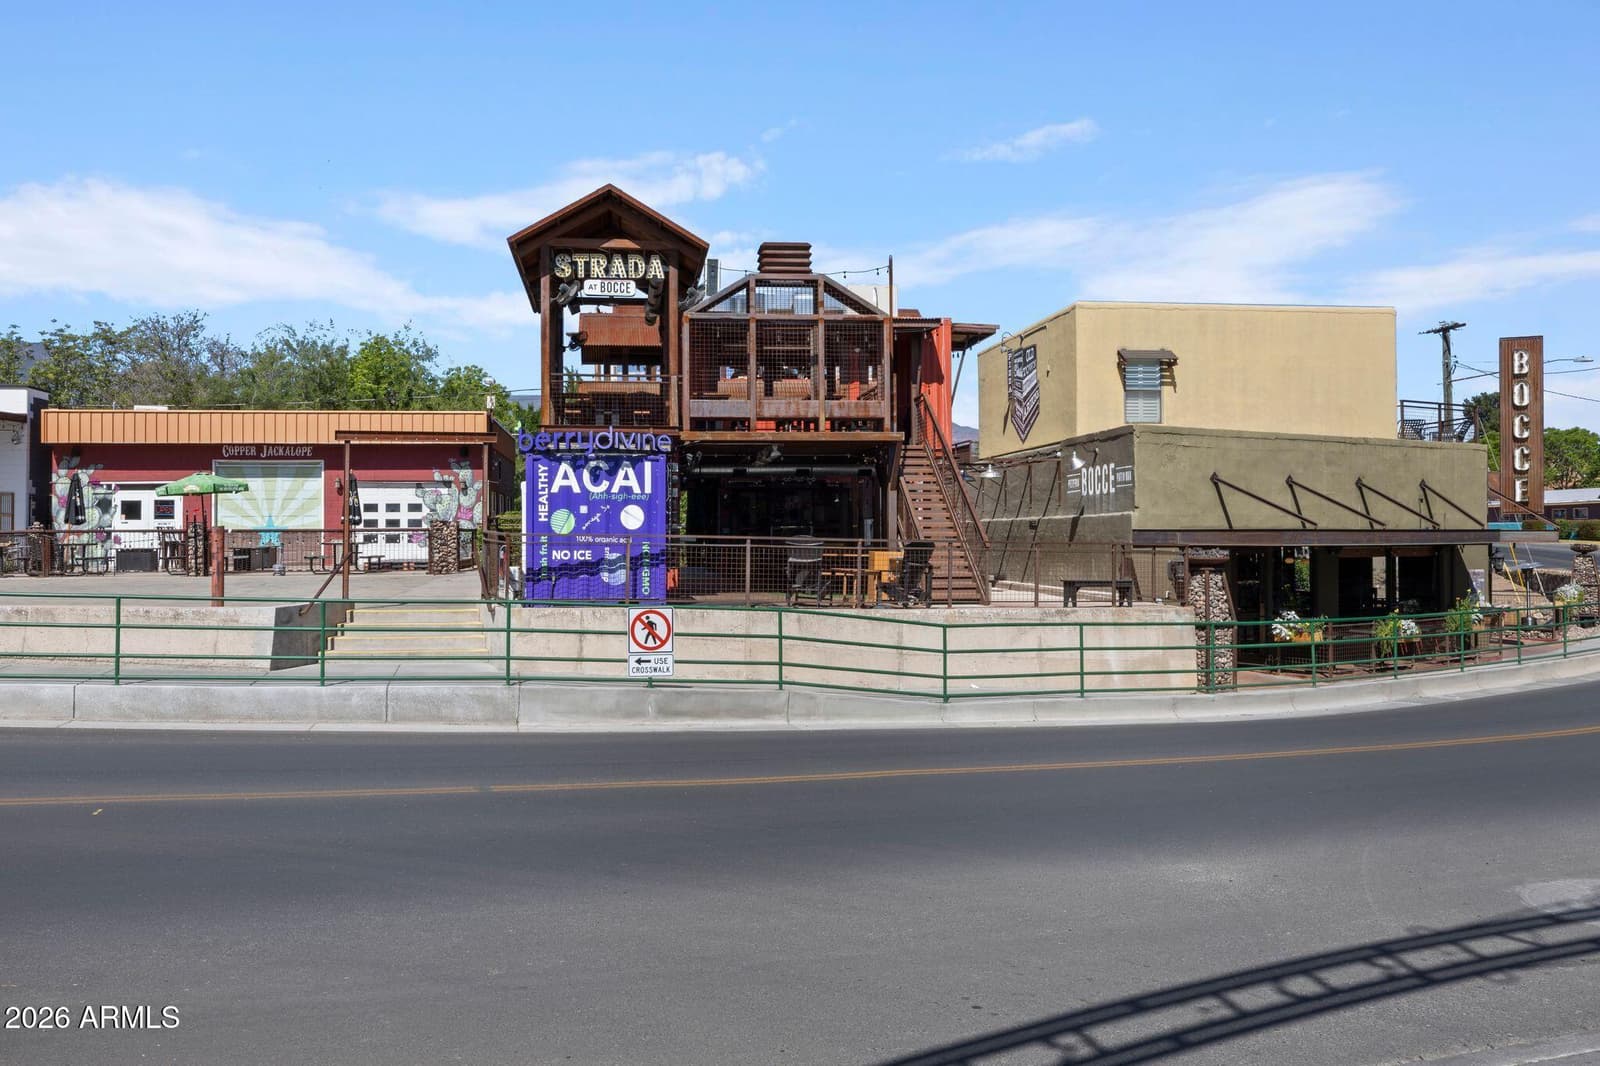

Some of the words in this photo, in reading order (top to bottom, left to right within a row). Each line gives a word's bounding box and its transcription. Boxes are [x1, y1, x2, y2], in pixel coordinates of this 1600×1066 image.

[553, 253, 665, 279] STRADA
[588, 283, 598, 291] AT
[600, 281, 631, 294] BOCCE
[1512, 349, 1531, 503] BOCCE
[517, 426, 672, 454] berrydivine
[550, 460, 653, 494] ACAI
[1081, 463, 1116, 496] BOCCE
[538, 464, 549, 522] HEALTHY
[552, 550, 571, 560] NO
[573, 550, 592, 560] ICE
[631, 666, 671, 674] CROSSWALK
[653, 657, 669, 665] USE
